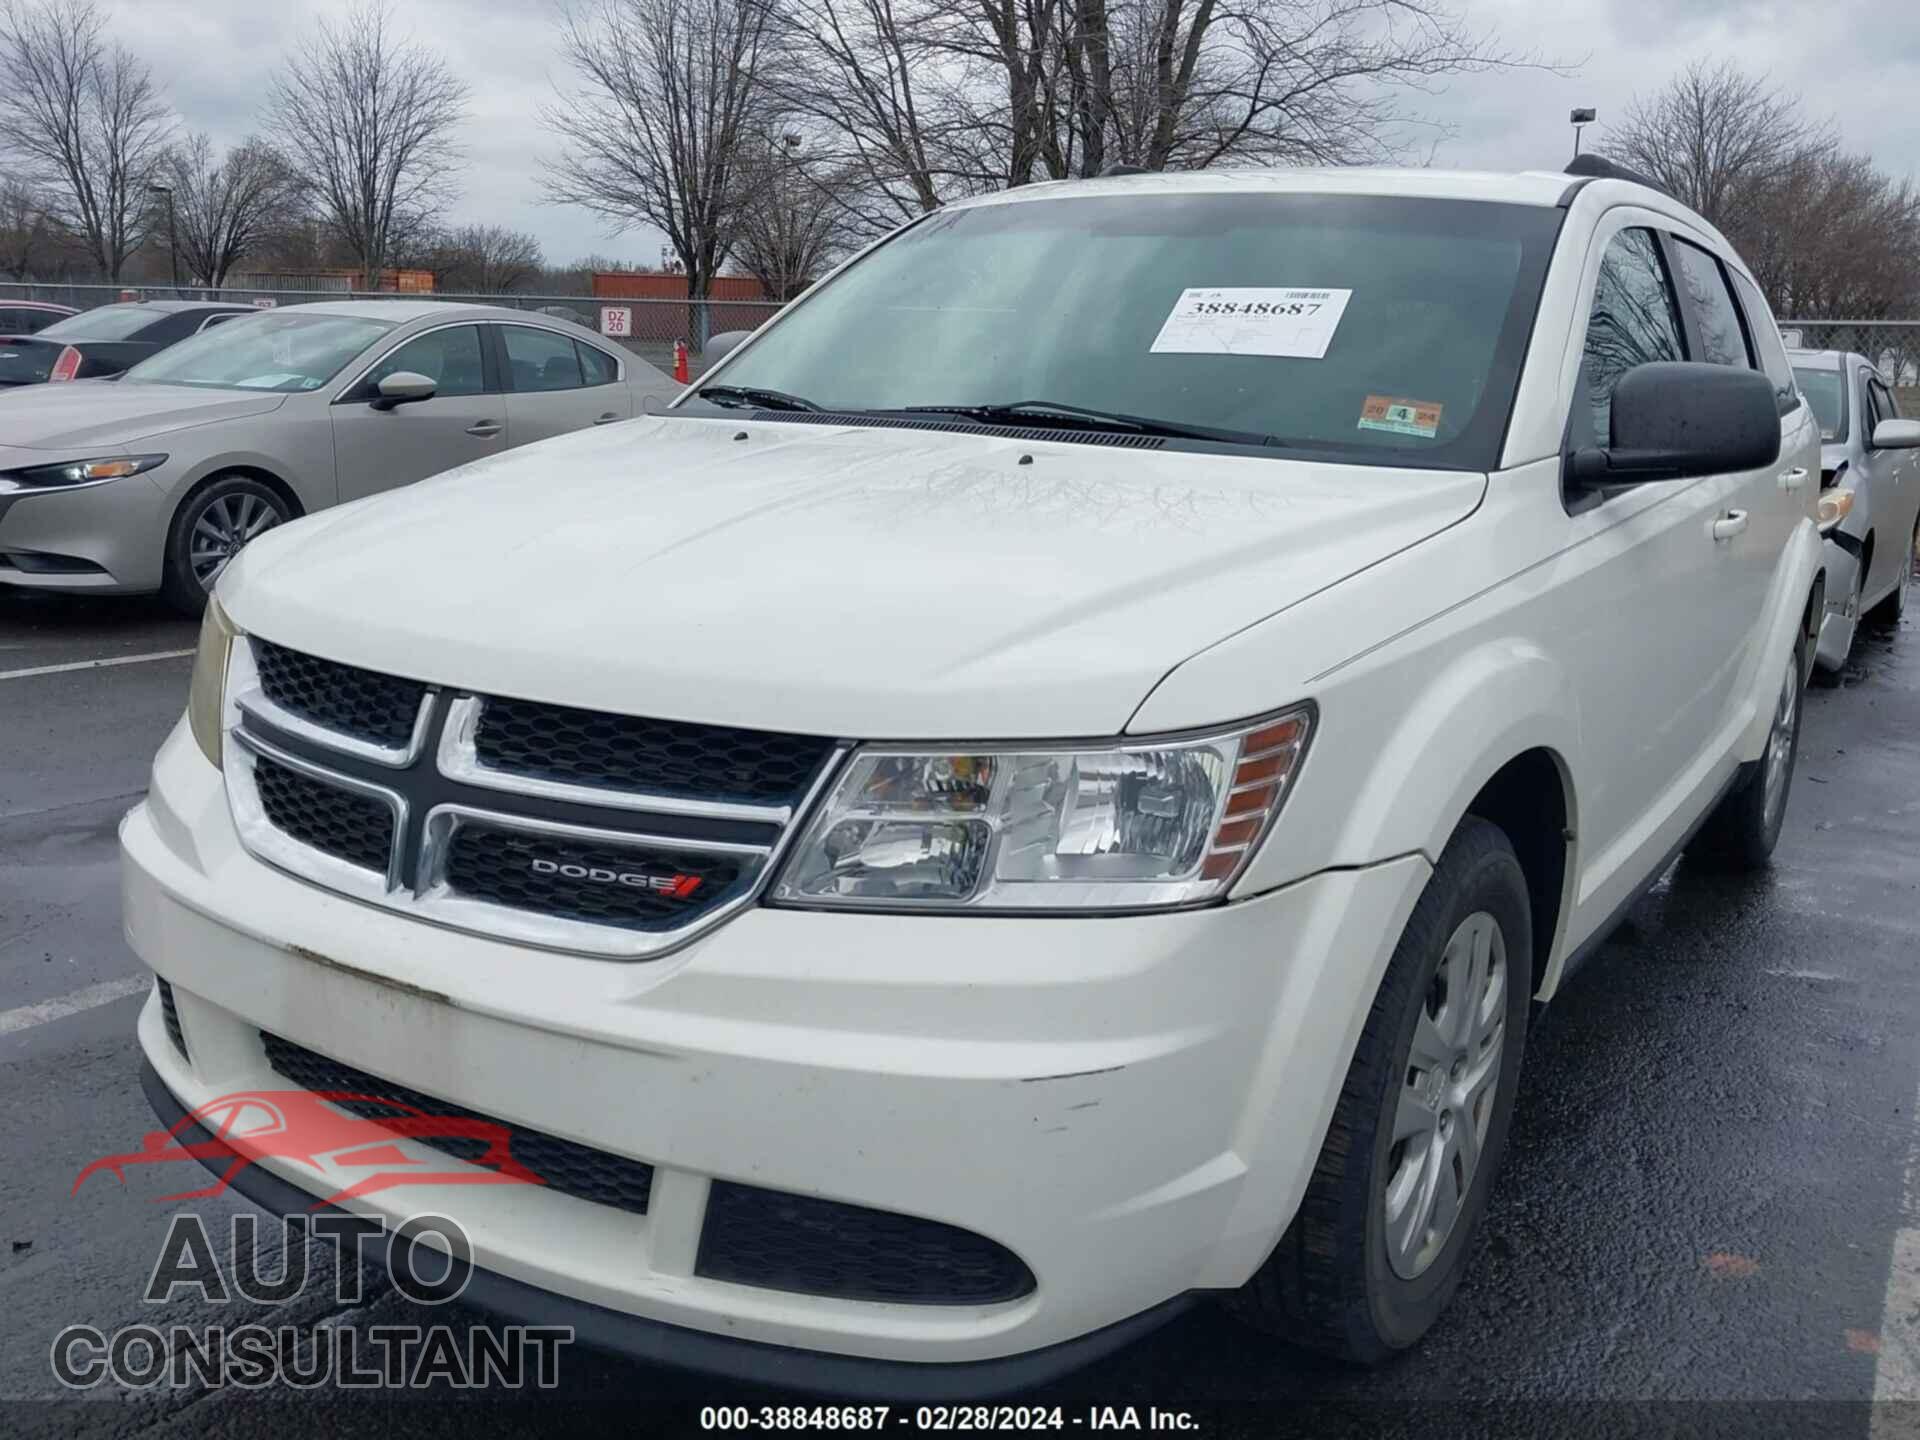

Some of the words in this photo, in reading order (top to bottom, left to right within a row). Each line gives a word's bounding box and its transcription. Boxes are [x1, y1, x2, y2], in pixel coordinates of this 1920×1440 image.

[1188, 302, 1322, 316] 38848687
[608, 311, 624, 321] DZ
[608, 322, 624, 332] 20
[1398, 408, 1408, 420] 4
[532, 859, 677, 890] DODGE
